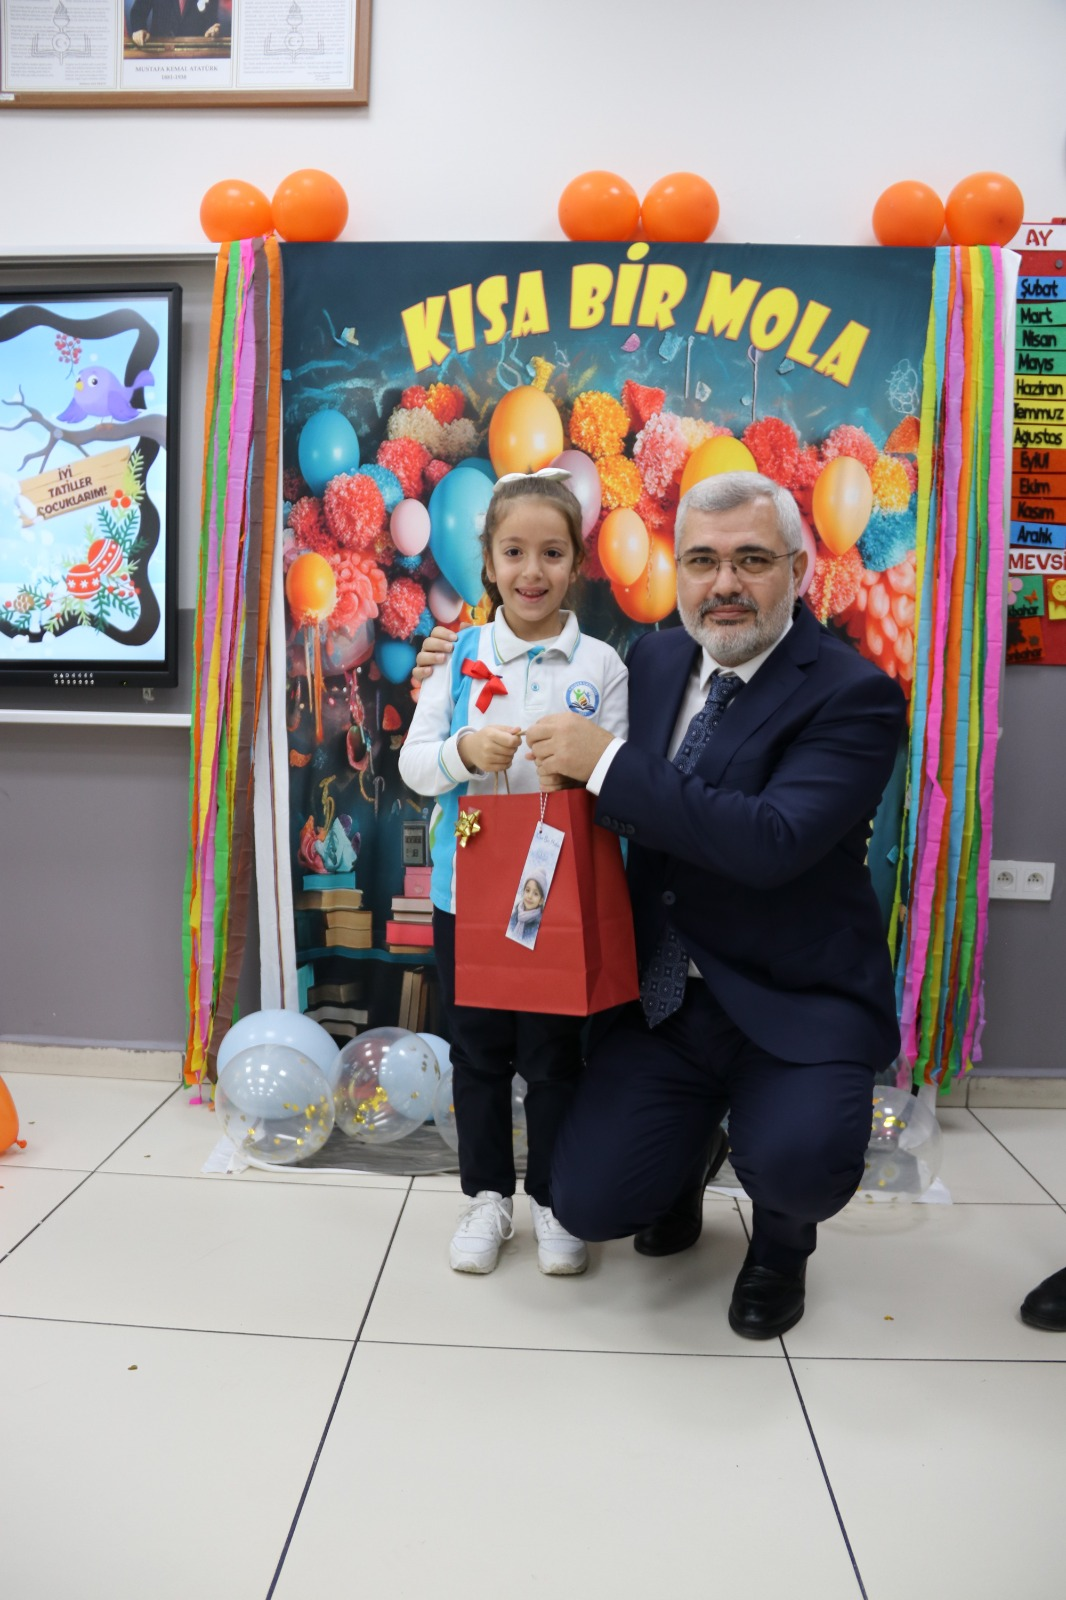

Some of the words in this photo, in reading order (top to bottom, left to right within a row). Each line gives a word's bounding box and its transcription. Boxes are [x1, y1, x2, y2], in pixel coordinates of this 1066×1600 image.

[189, 64, 218, 72] ATATÜRK
[1026, 229, 1053, 246] AY
[1020, 278, 1058, 299] Şubat
[401, 270, 550, 372] KISA
[569, 241, 688, 331] BİR
[695, 270, 870, 387] MOLA
[1021, 306, 1053, 324] Mart
[1022, 329, 1057, 347] Nisan
[1018, 353, 1054, 374] Mayıs
[1016, 379, 1063, 396] Haziran
[1013, 403, 1064, 420] Temmuz
[1014, 427, 1063, 448] Ağustos
[58, 464, 73, 480] İYİ
[48, 476, 93, 498] TATİLLER
[1019, 478, 1050, 495] Ekim
[37, 485, 107, 517] ÇOCUKLARIM!
[1017, 502, 1055, 520] Kasım
[1017, 525, 1052, 544] Aralık
